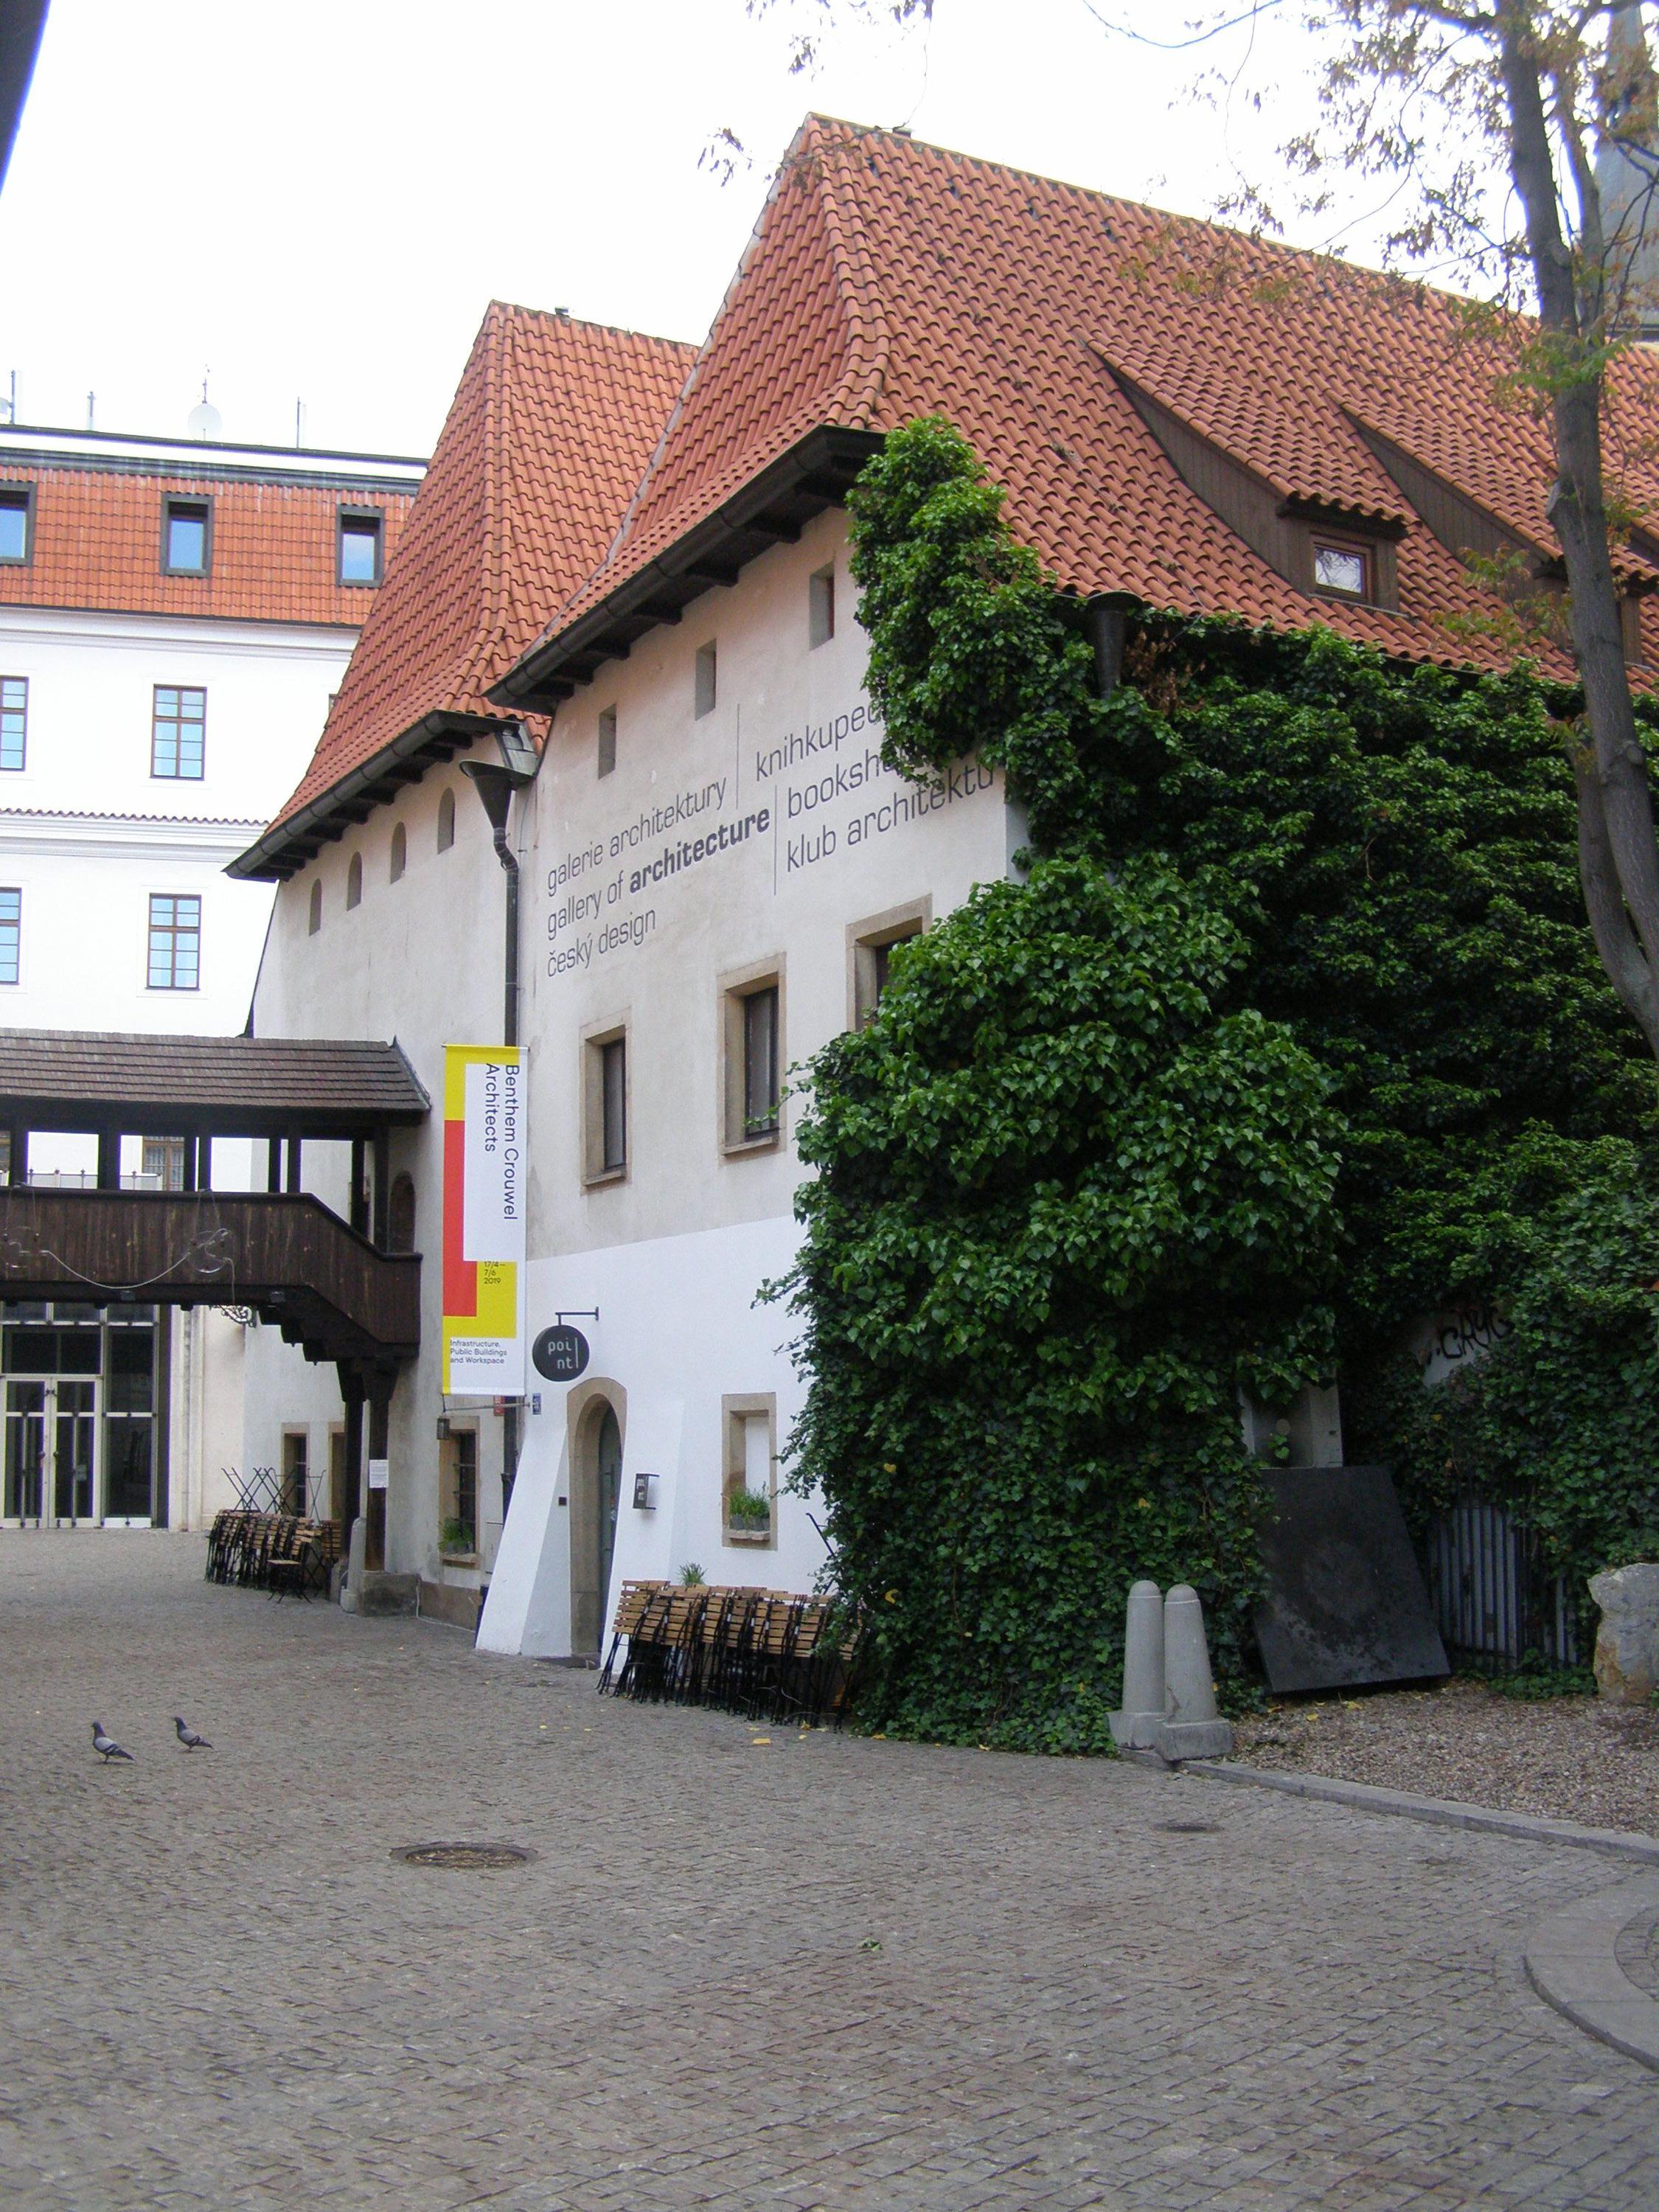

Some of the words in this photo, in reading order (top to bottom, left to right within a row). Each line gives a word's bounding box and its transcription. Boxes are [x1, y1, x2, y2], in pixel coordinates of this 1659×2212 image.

[547, 841, 604, 897] galerie
[609, 777, 727, 858] architektury
[787, 824, 837, 873] klub
[547, 889, 602, 942] gallery
[607, 869, 625, 905] of
[629, 808, 771, 894] architecture
[547, 932, 593, 977] český
[598, 909, 656, 955] design
[484, 1062, 500, 1152] Architects
[504, 1064, 521, 1142] Benthem
[504, 1147, 519, 1220] Crouwel
[483, 1269, 496, 1277] 7/6
[465, 1357, 505, 1365] Workspace
[474, 1349, 508, 1357] Buildings
[548, 1337, 573, 1356] poi
[557, 1357, 574, 1369] nt
